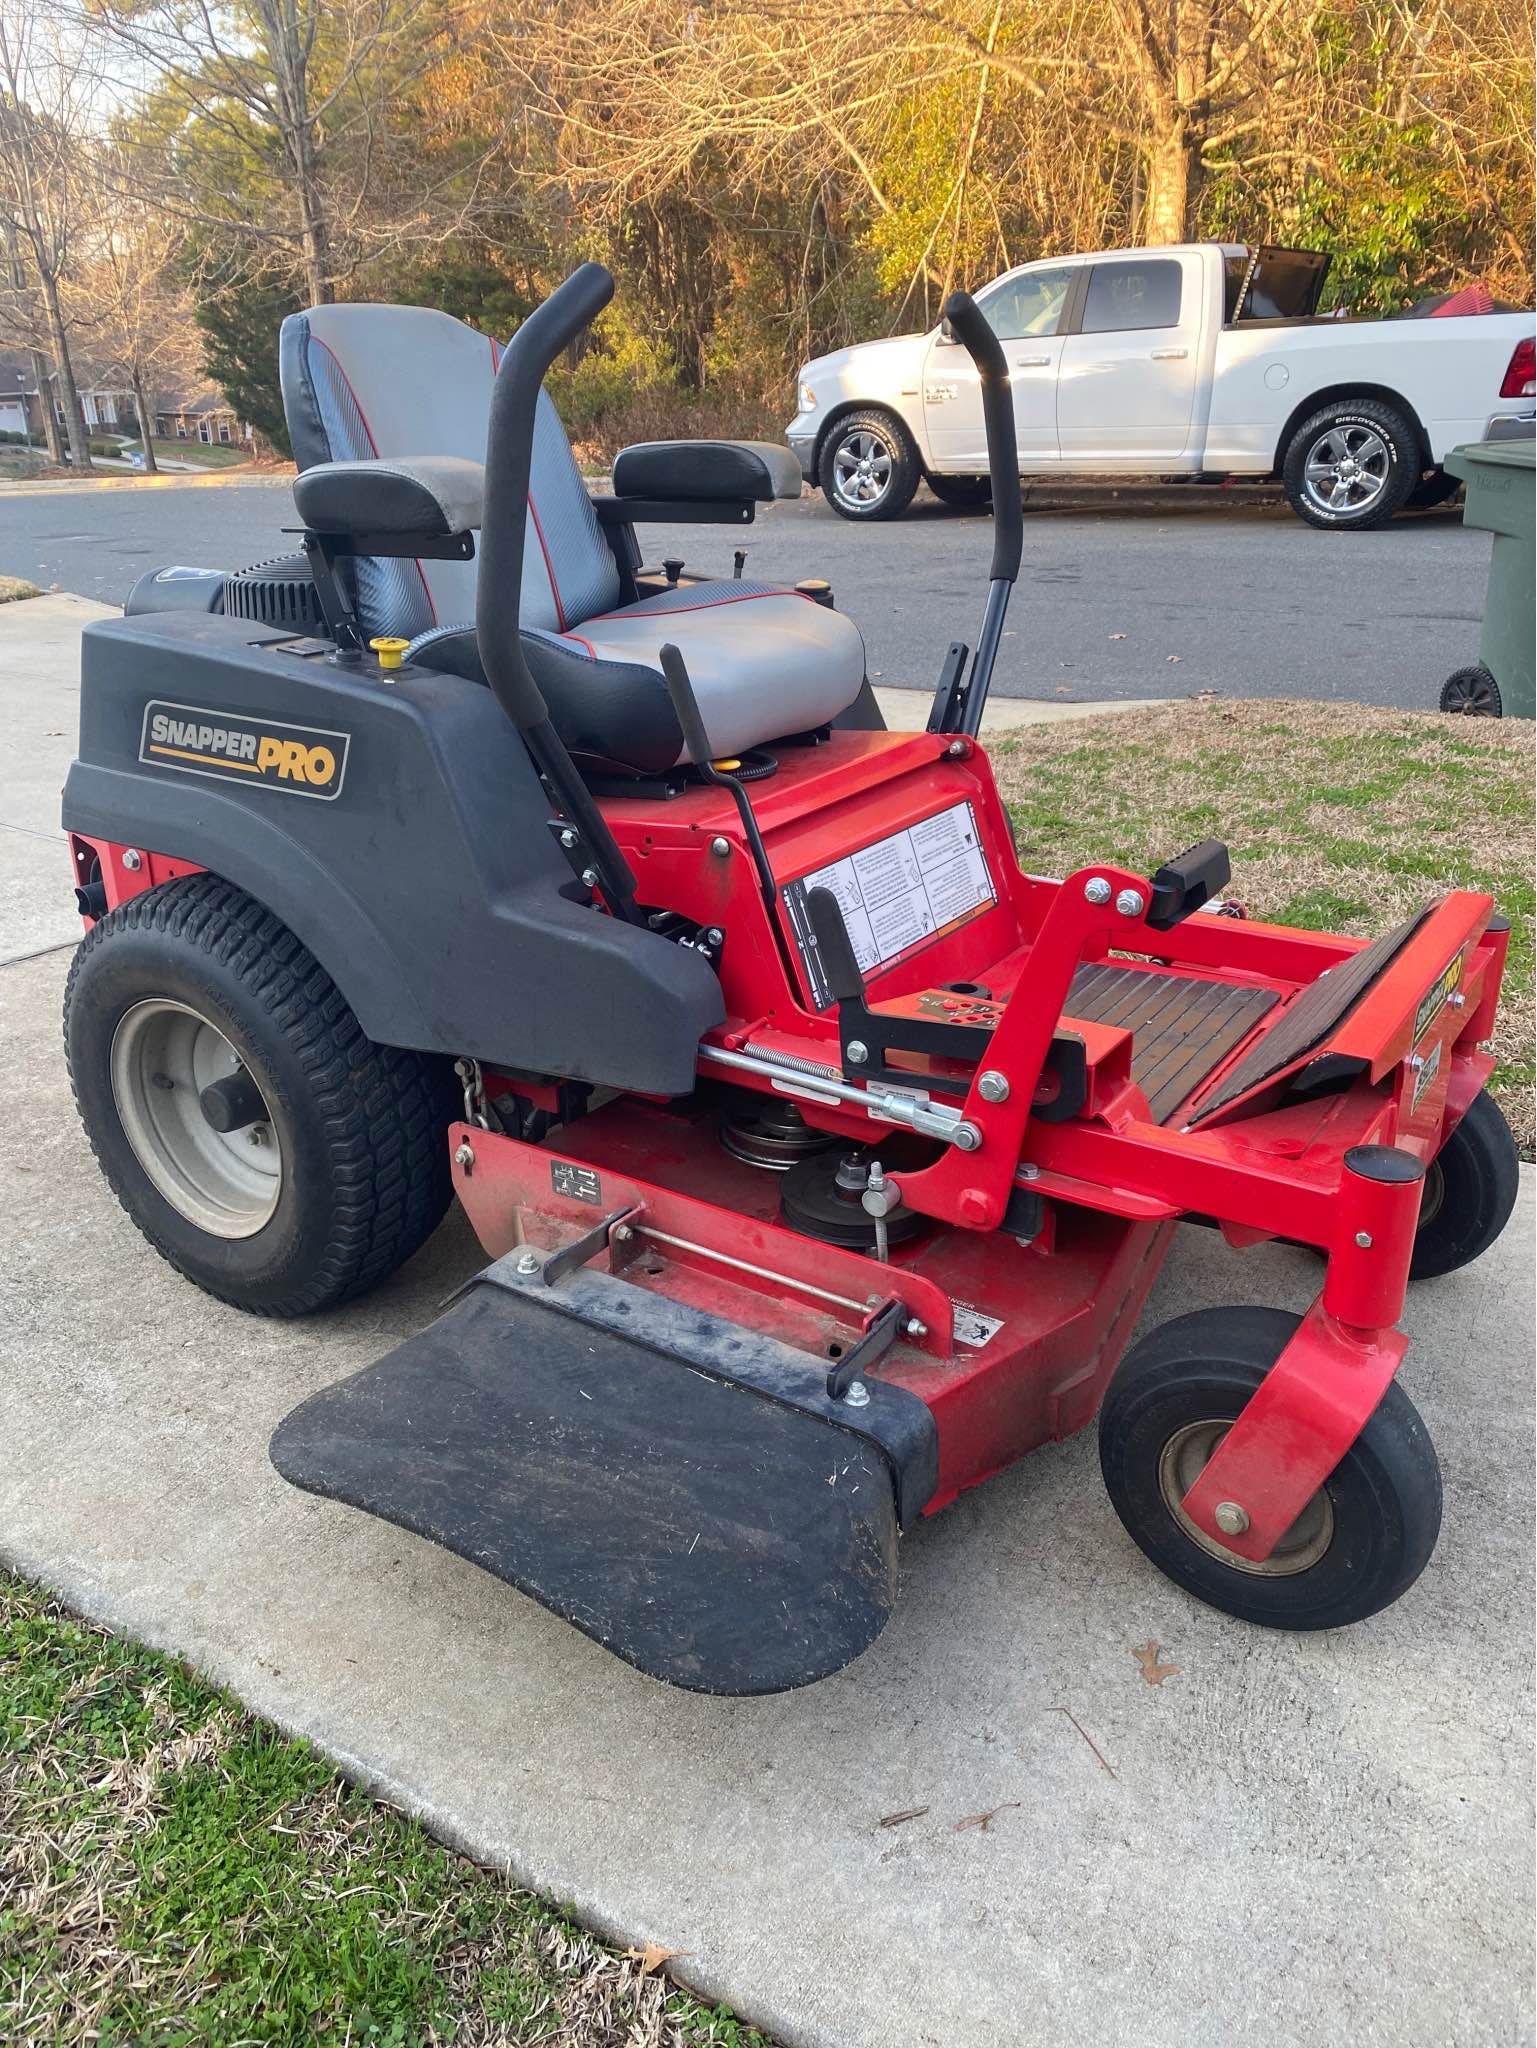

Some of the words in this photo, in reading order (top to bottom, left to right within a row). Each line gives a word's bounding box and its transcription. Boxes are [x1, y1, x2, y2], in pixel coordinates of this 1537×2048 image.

[1335, 416, 1389, 440] DISCOVERER
[1300, 494, 1336, 520] COOPER
[151, 714, 257, 760] SNAPPER
[257, 727, 336, 786] PRO
